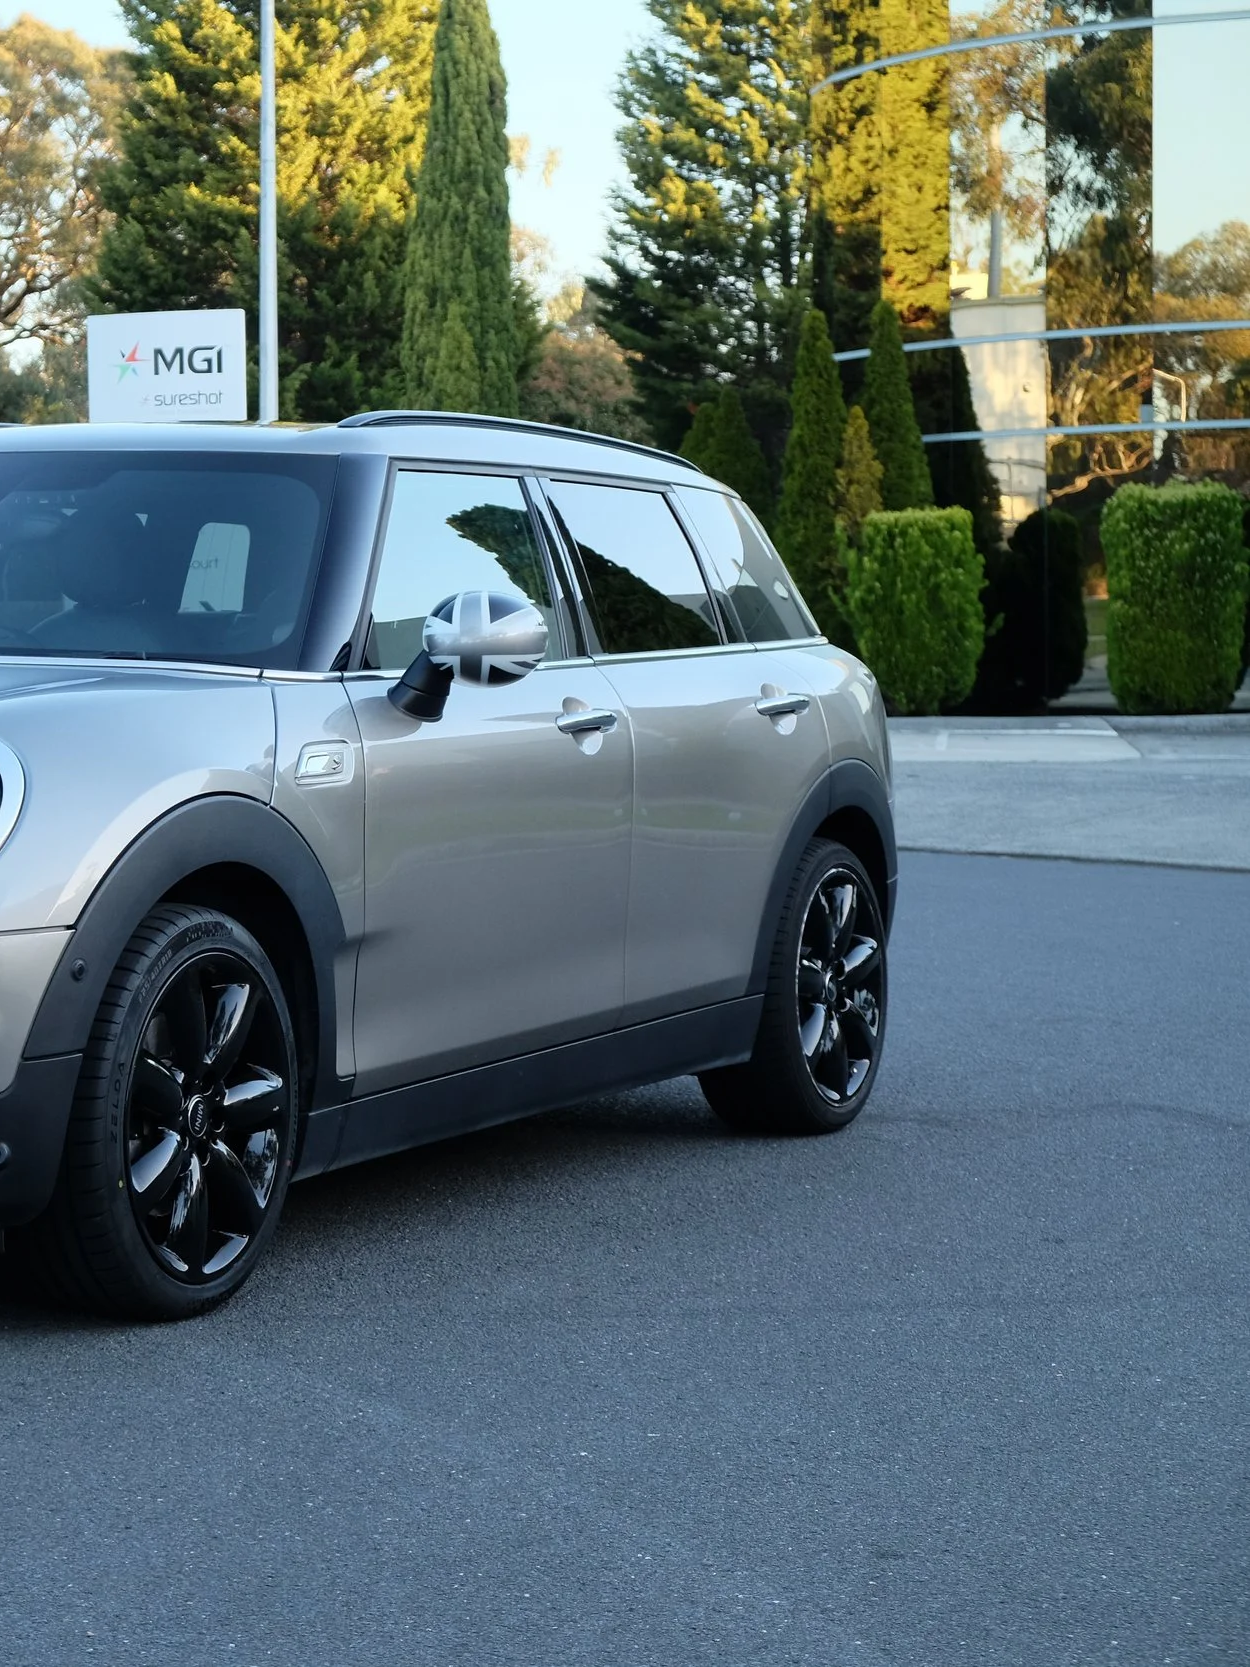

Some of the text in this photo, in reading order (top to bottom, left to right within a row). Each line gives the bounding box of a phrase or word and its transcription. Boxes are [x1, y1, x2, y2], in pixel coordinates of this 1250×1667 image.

[153, 345, 223, 376] MGI
[154, 390, 223, 407] sureshot
[190, 557, 219, 570] ourt
[194, 1103, 204, 1131] MINI
